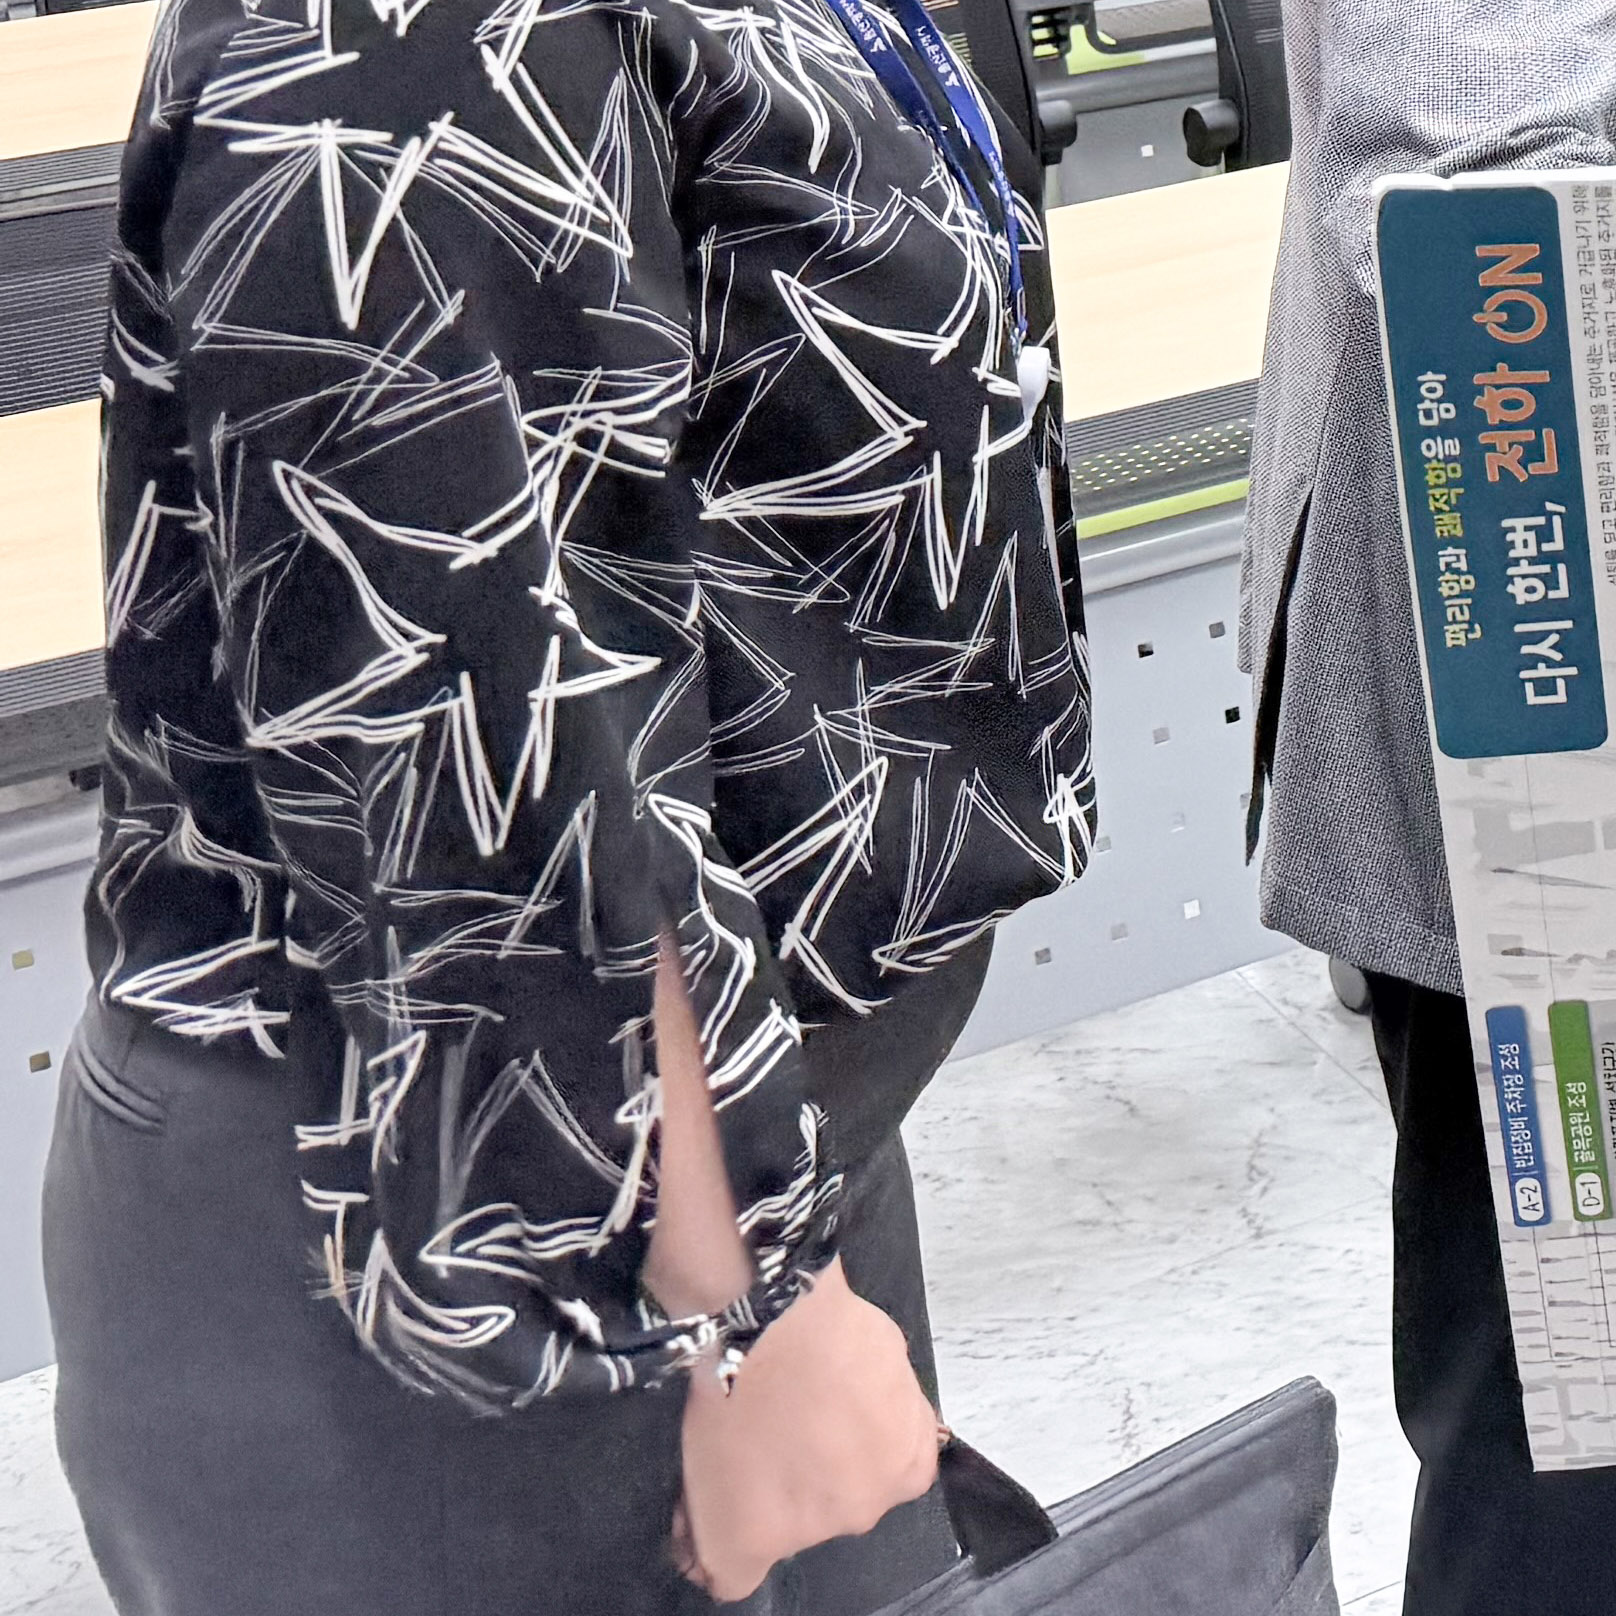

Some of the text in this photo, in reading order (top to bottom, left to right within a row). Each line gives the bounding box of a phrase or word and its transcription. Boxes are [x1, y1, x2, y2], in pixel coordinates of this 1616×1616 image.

[1417, 370, 1482, 647] 편리함과 쾌적함을 담아
[1472, 243, 1578, 705] 다시 한번, 전하 ON
[1498, 1043, 1540, 1212] A-2 빈집정비 주차장 조성
[1565, 1081, 1600, 1206] D-1 골목공원 조성
